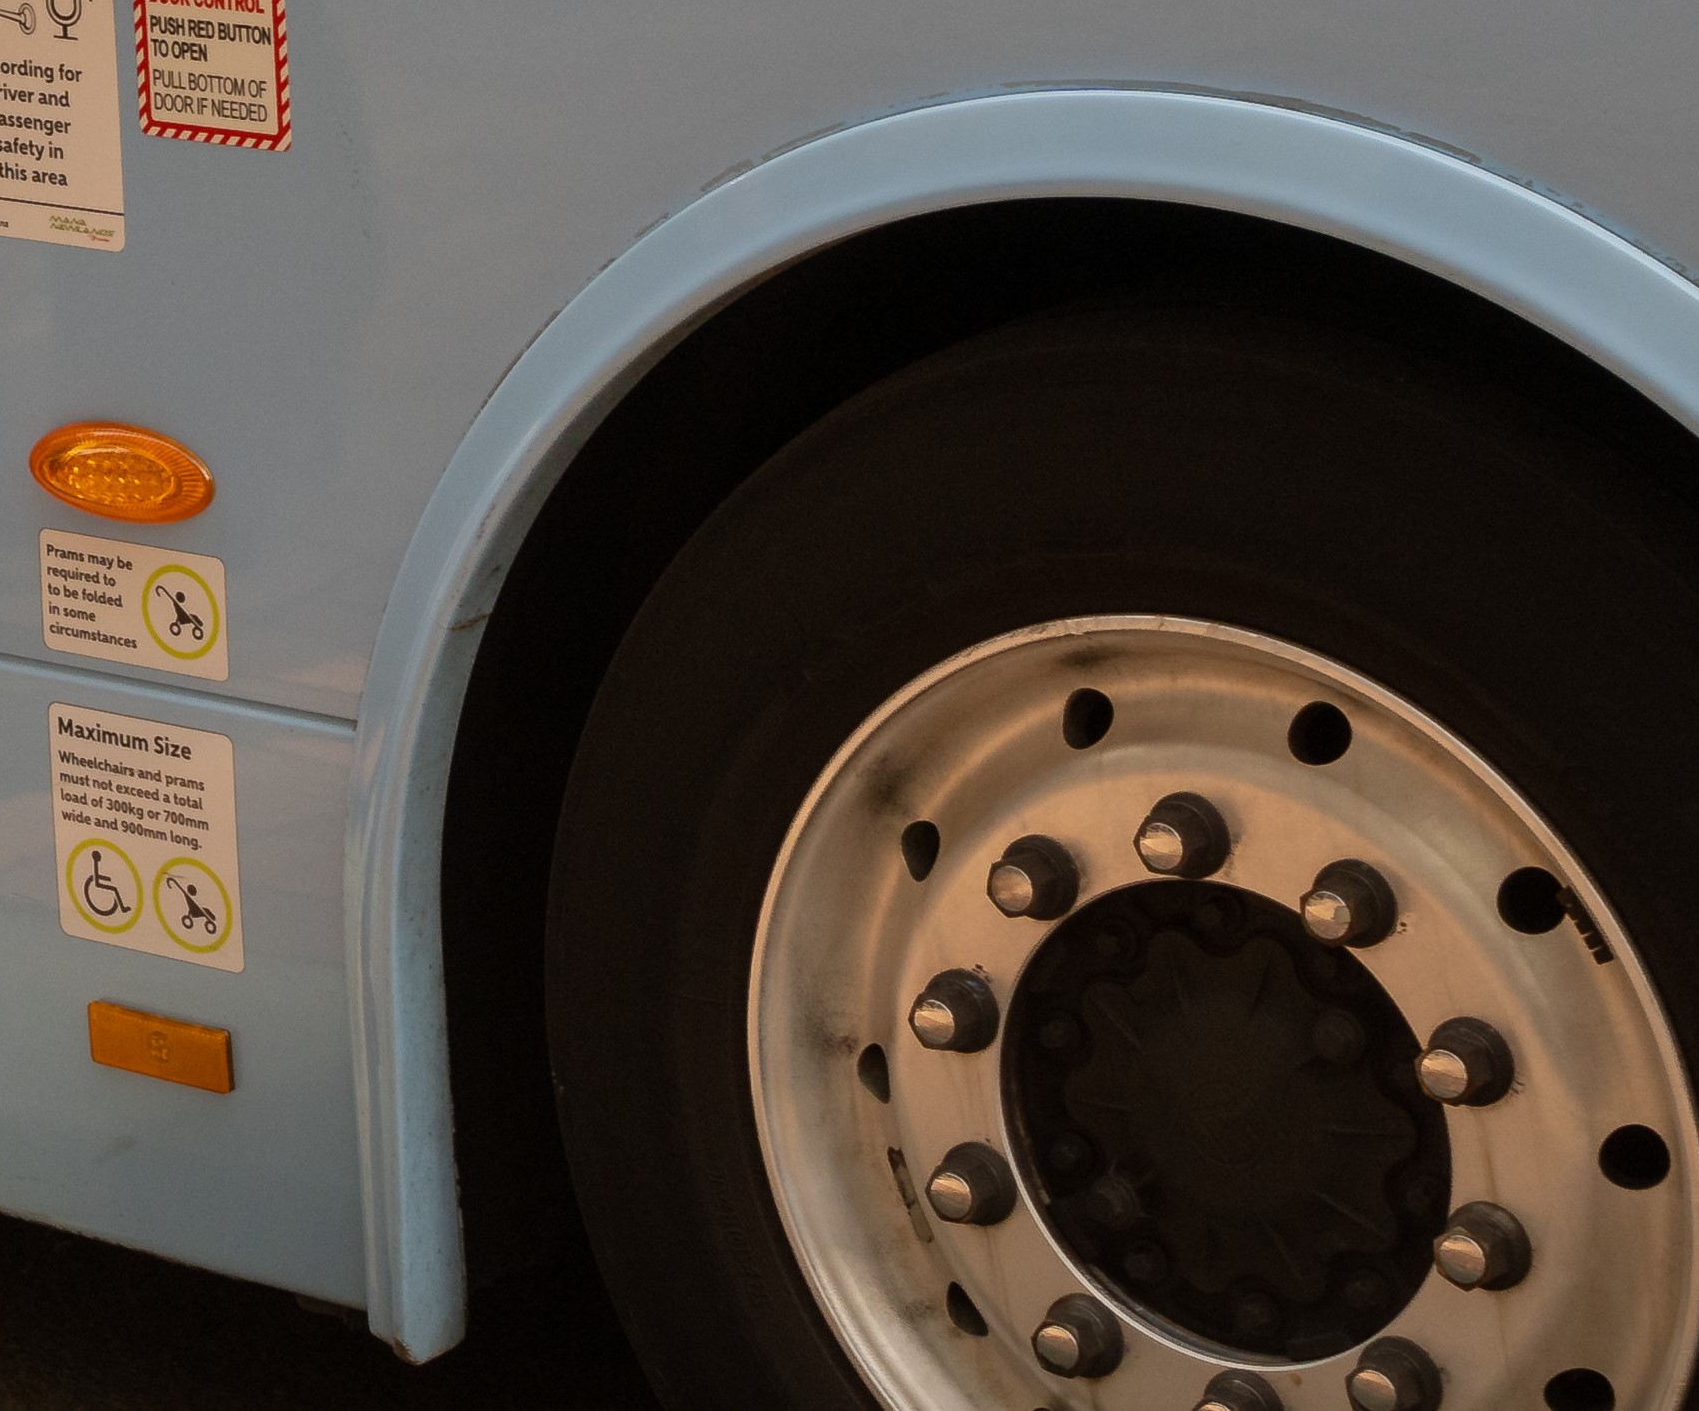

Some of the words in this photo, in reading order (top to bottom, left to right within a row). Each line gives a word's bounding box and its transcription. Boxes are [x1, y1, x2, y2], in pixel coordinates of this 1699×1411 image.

[149, 15, 185, 36] PUSH
[188, 19, 215, 39] RED
[217, 22, 272, 46] BUTTON
[150, 38, 169, 57] TO
[171, 41, 208, 62] OPEN
[58, 63, 83, 83] for
[152, 68, 186, 90] PULL
[188, 72, 246, 96] BOTTOM
[248, 79, 267, 98] OF
[38, 90, 71, 108] and
[154, 92, 194, 114] DOOR
[197, 97, 208, 115] IF
[211, 98, 267, 122] NEEDED
[48, 141, 64, 160] in
[31, 170, 69, 186] area
[46, 543, 85, 562] Prams
[87, 553, 115, 570] may
[116, 555, 133, 570] be
[46, 566, 101, 584] required
[103, 573, 117, 587] to
[47, 582, 61, 596] to
[63, 584, 79, 599] be
[82, 587, 124, 608] folded
[48, 601, 60, 615] in
[63, 607, 96, 622] some
[49, 621, 138, 649] circumstances
[57, 716, 149, 752] Maximum
[153, 735, 192, 760] Size
[58, 749, 135, 777] Wheelchairs
[137, 770, 162, 783] and
[164, 774, 205, 792] prams
[59, 772, 90, 787] must
[92, 778, 113, 791] not
[115, 783, 160, 801] exceed
[162, 793, 171, 804] a
[173, 793, 203, 810] total
[60, 788, 88, 806] load
[90, 796, 103, 809] of
[106, 798, 144, 820] 300kg
[147, 809, 161, 821] or
[163, 809, 209, 831] 700mm
[61, 809, 92, 825] wide
[94, 817, 119, 831] and
[121, 820, 168, 842] 900mm
[169, 830, 203, 851] long.
